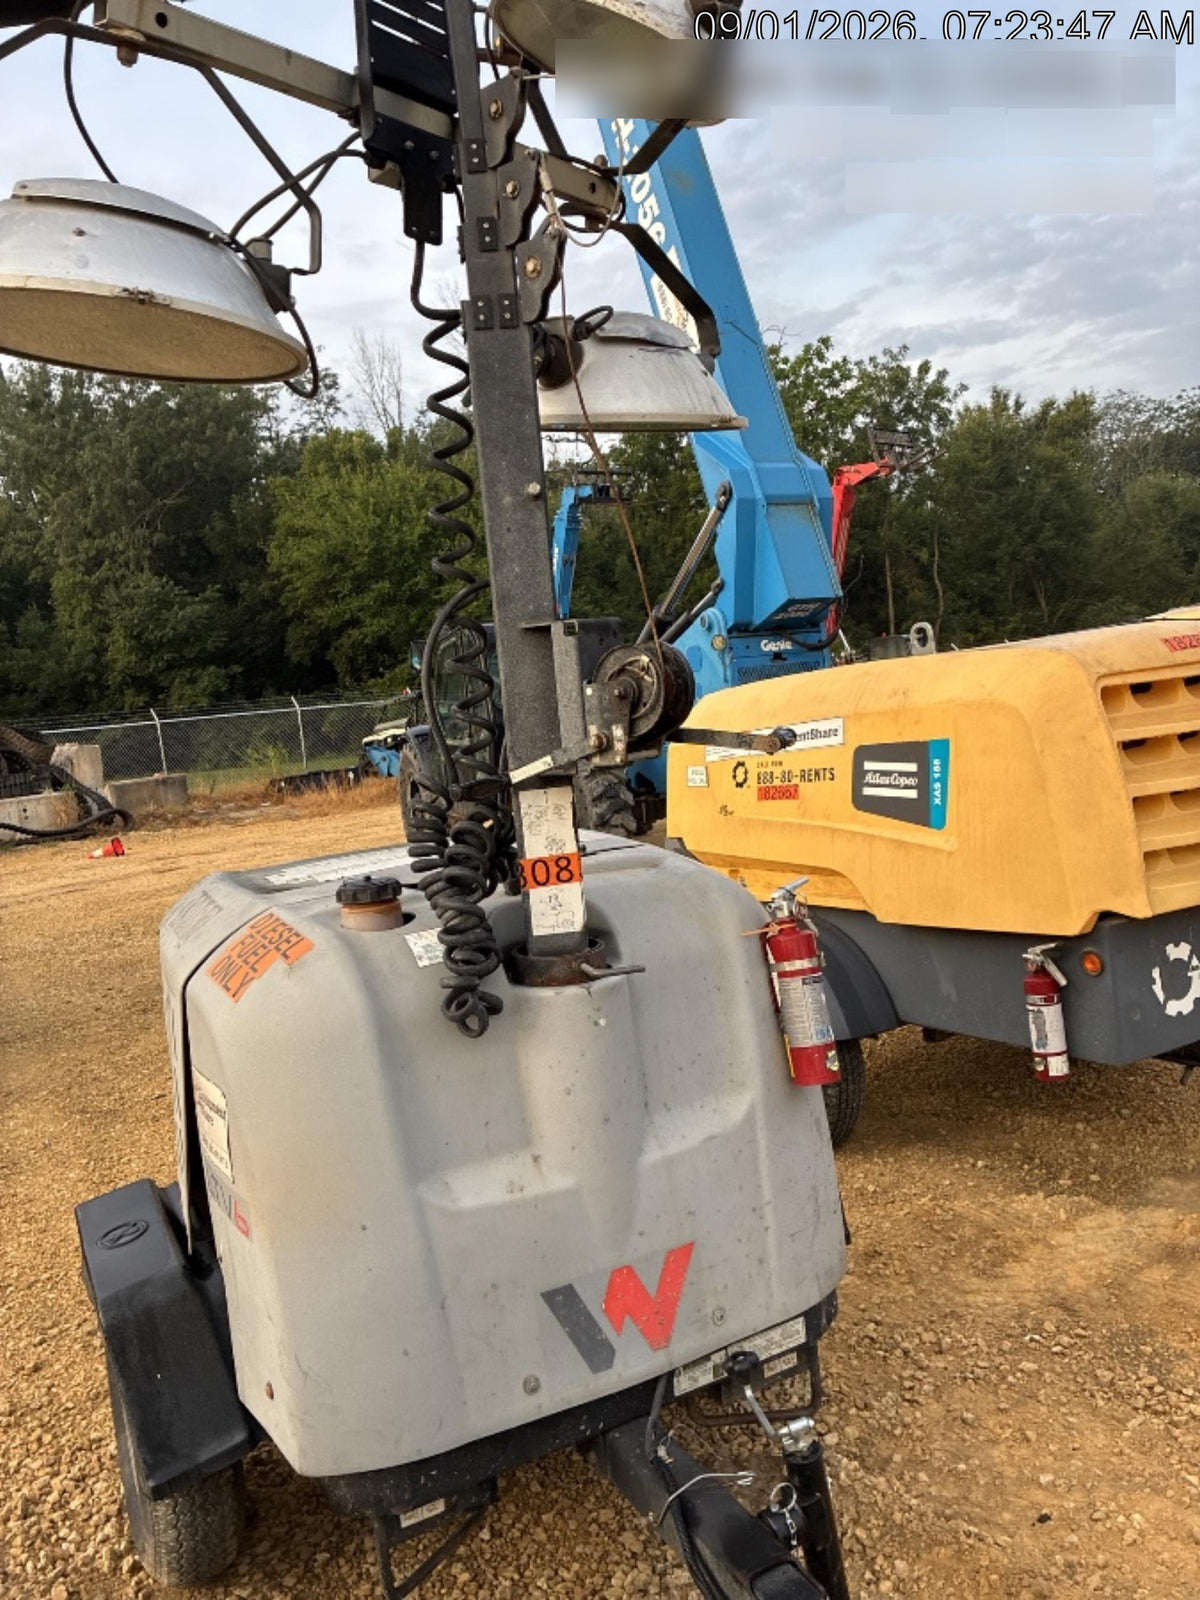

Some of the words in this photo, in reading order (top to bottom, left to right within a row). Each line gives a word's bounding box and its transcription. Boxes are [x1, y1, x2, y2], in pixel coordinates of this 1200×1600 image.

[863, 771, 889, 786] Atlas
[890, 772, 918, 788] Copco
[932, 781, 941, 806] XAS
[230, 932, 273, 973] FUEL
[249, 912, 304, 960] DIESEL
[210, 954, 255, 998] ONLY
